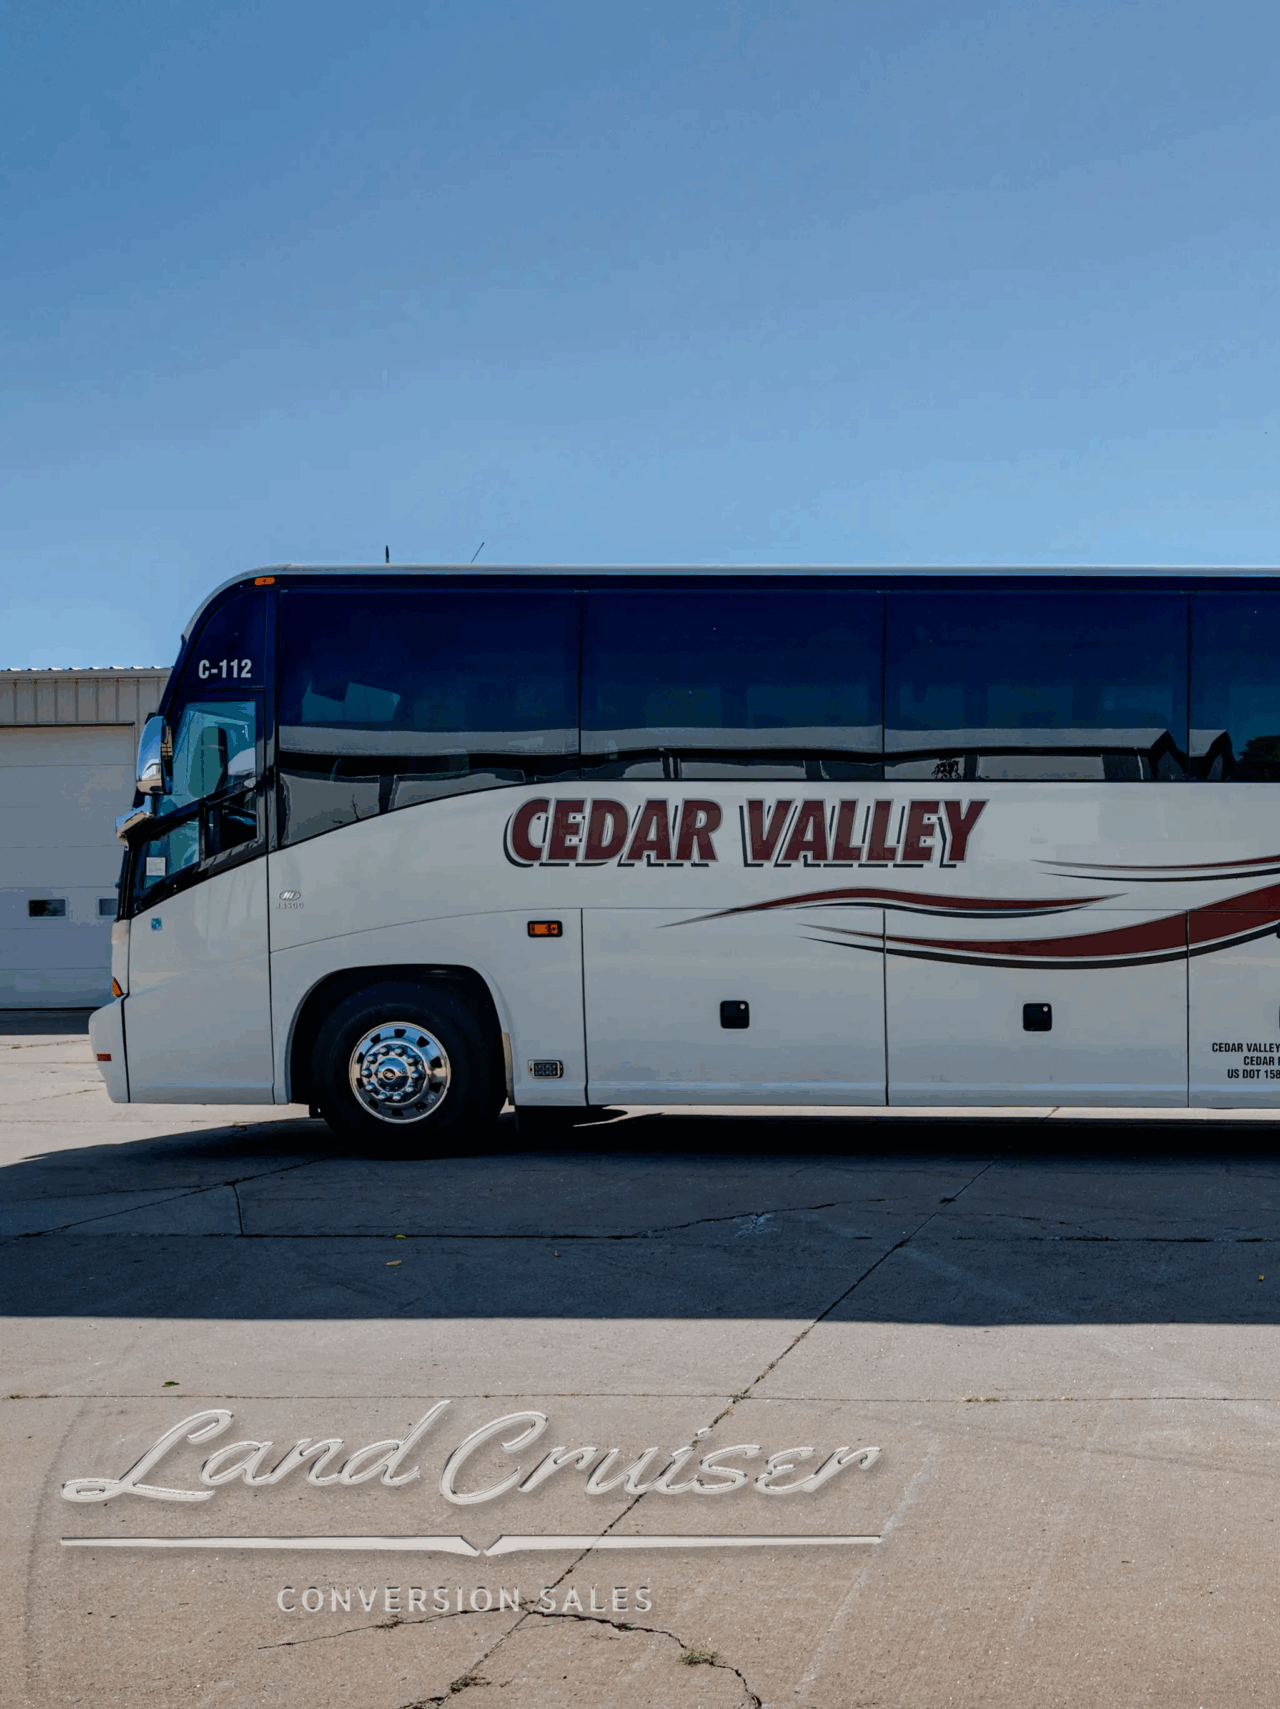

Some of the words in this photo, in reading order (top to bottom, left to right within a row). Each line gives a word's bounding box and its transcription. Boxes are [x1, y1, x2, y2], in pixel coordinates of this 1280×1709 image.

[198, 658, 252, 679] C-112
[503, 797, 724, 868] CEDAR
[739, 798, 990, 868] VALLEY
[1212, 1042, 1243, 1053] CEDAR
[1246, 1043, 1280, 1053] VALLEY
[1243, 1056, 1275, 1066] CEDAR
[1227, 1069, 1240, 1079] US
[1242, 1069, 1261, 1079] DOT
